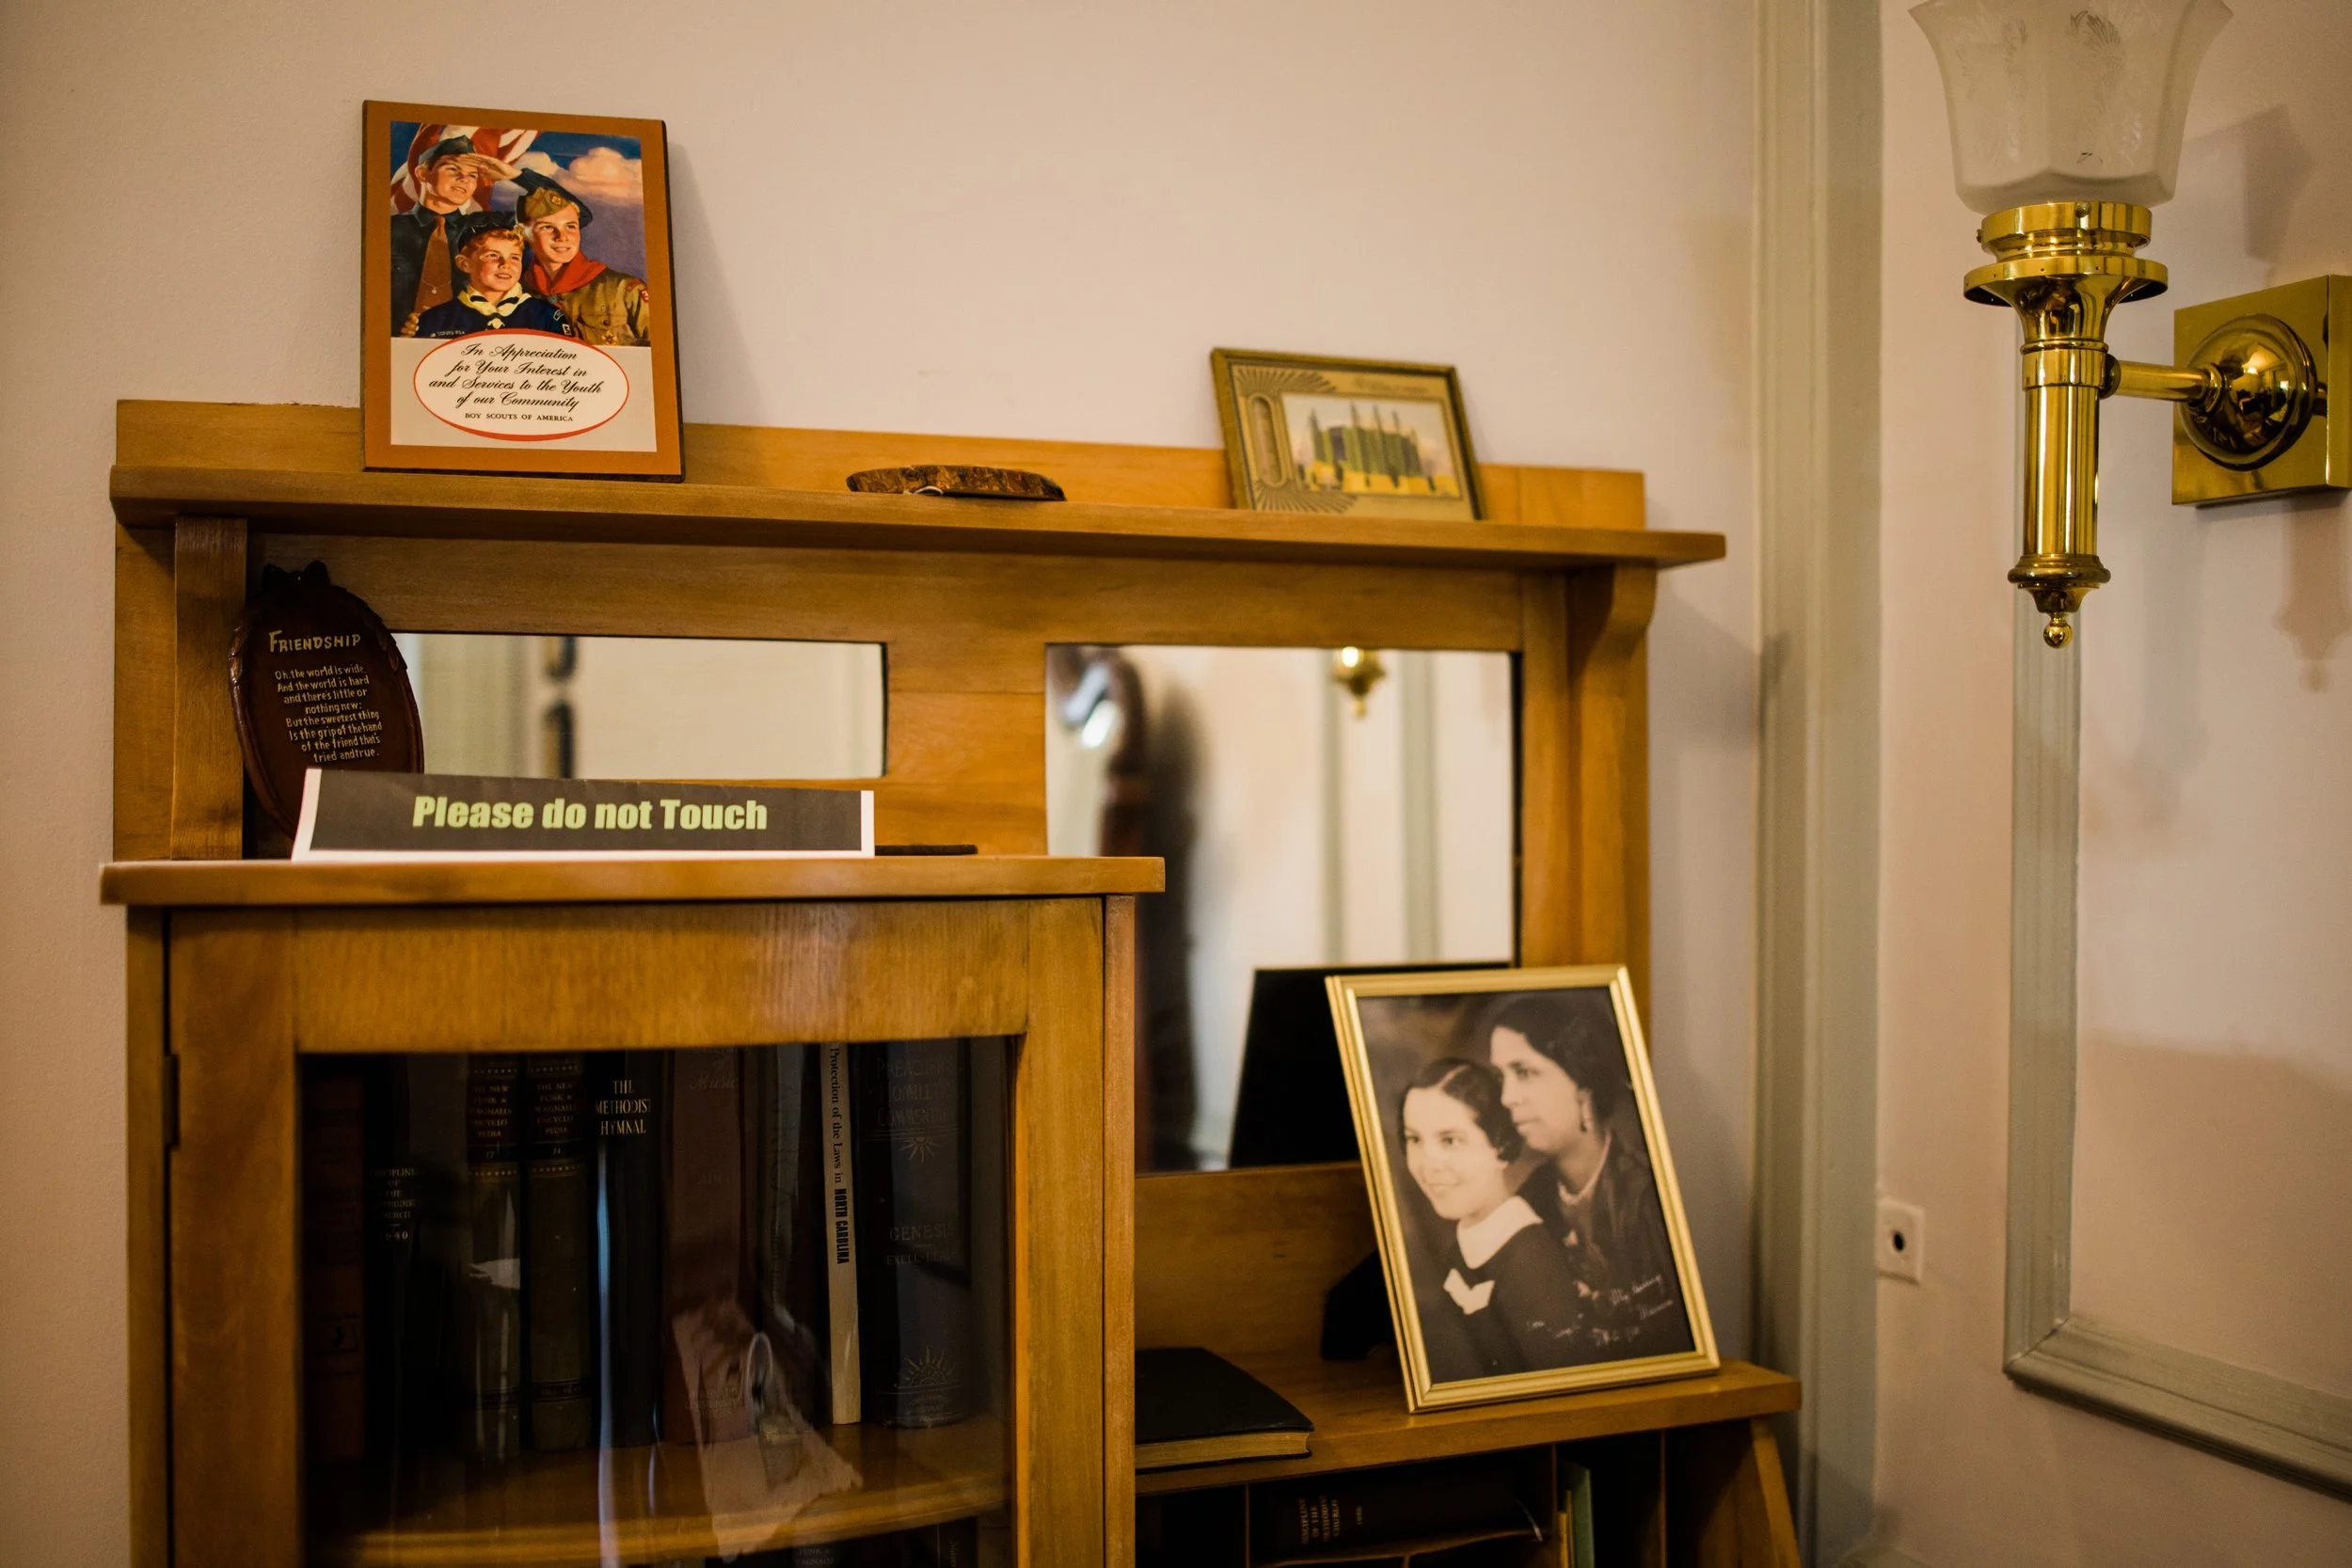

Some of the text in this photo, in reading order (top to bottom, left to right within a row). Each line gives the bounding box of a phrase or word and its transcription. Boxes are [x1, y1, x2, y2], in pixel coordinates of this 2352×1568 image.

[461, 343, 577, 361] In Appreciation
[444, 359, 587, 377] for Your Interest in
[429, 375, 605, 394] and Services to the Youth
[455, 391, 580, 413] of our Community
[536, 414, 573, 422] AMERICA
[290, 668, 305, 679] the
[307, 665, 333, 678] world
[277, 674, 370, 693] And the world is hard
[284, 693, 302, 705] and
[333, 688, 356, 700] little
[357, 688, 368, 698] or
[305, 701, 340, 715] nothing
[285, 709, 380, 728] But the sweetest thing
[289, 721, 383, 741] Is the grip of the hand
[301, 740, 311, 752] of
[314, 739, 330, 751] the
[332, 735, 358, 749] friend
[313, 751, 337, 764] tried
[340, 750, 356, 760] and
[412, 796, 768, 830] Please do not Touch
[489, 1085, 510, 1093] NEW
[536, 1083, 552, 1092] THE
[612, 1079, 634, 1095] THE
[539, 1093, 565, 1103] FUNK
[595, 1098, 652, 1116] METHODIST
[472, 1108, 513, 1117] AGNALLS
[473, 1118, 508, 1127] NCYCLO
[599, 1118, 647, 1136] HYMNAL
[829, 1048, 850, 1265] Protection of the Laws in NORTH CAROLINA
[889, 1223, 957, 1242] GENESIS
[1297, 1497, 1310, 1544] DISCIPLINE
[1310, 1505, 1321, 1539] OF THE
[1331, 1498, 1341, 1538] CHURCH
